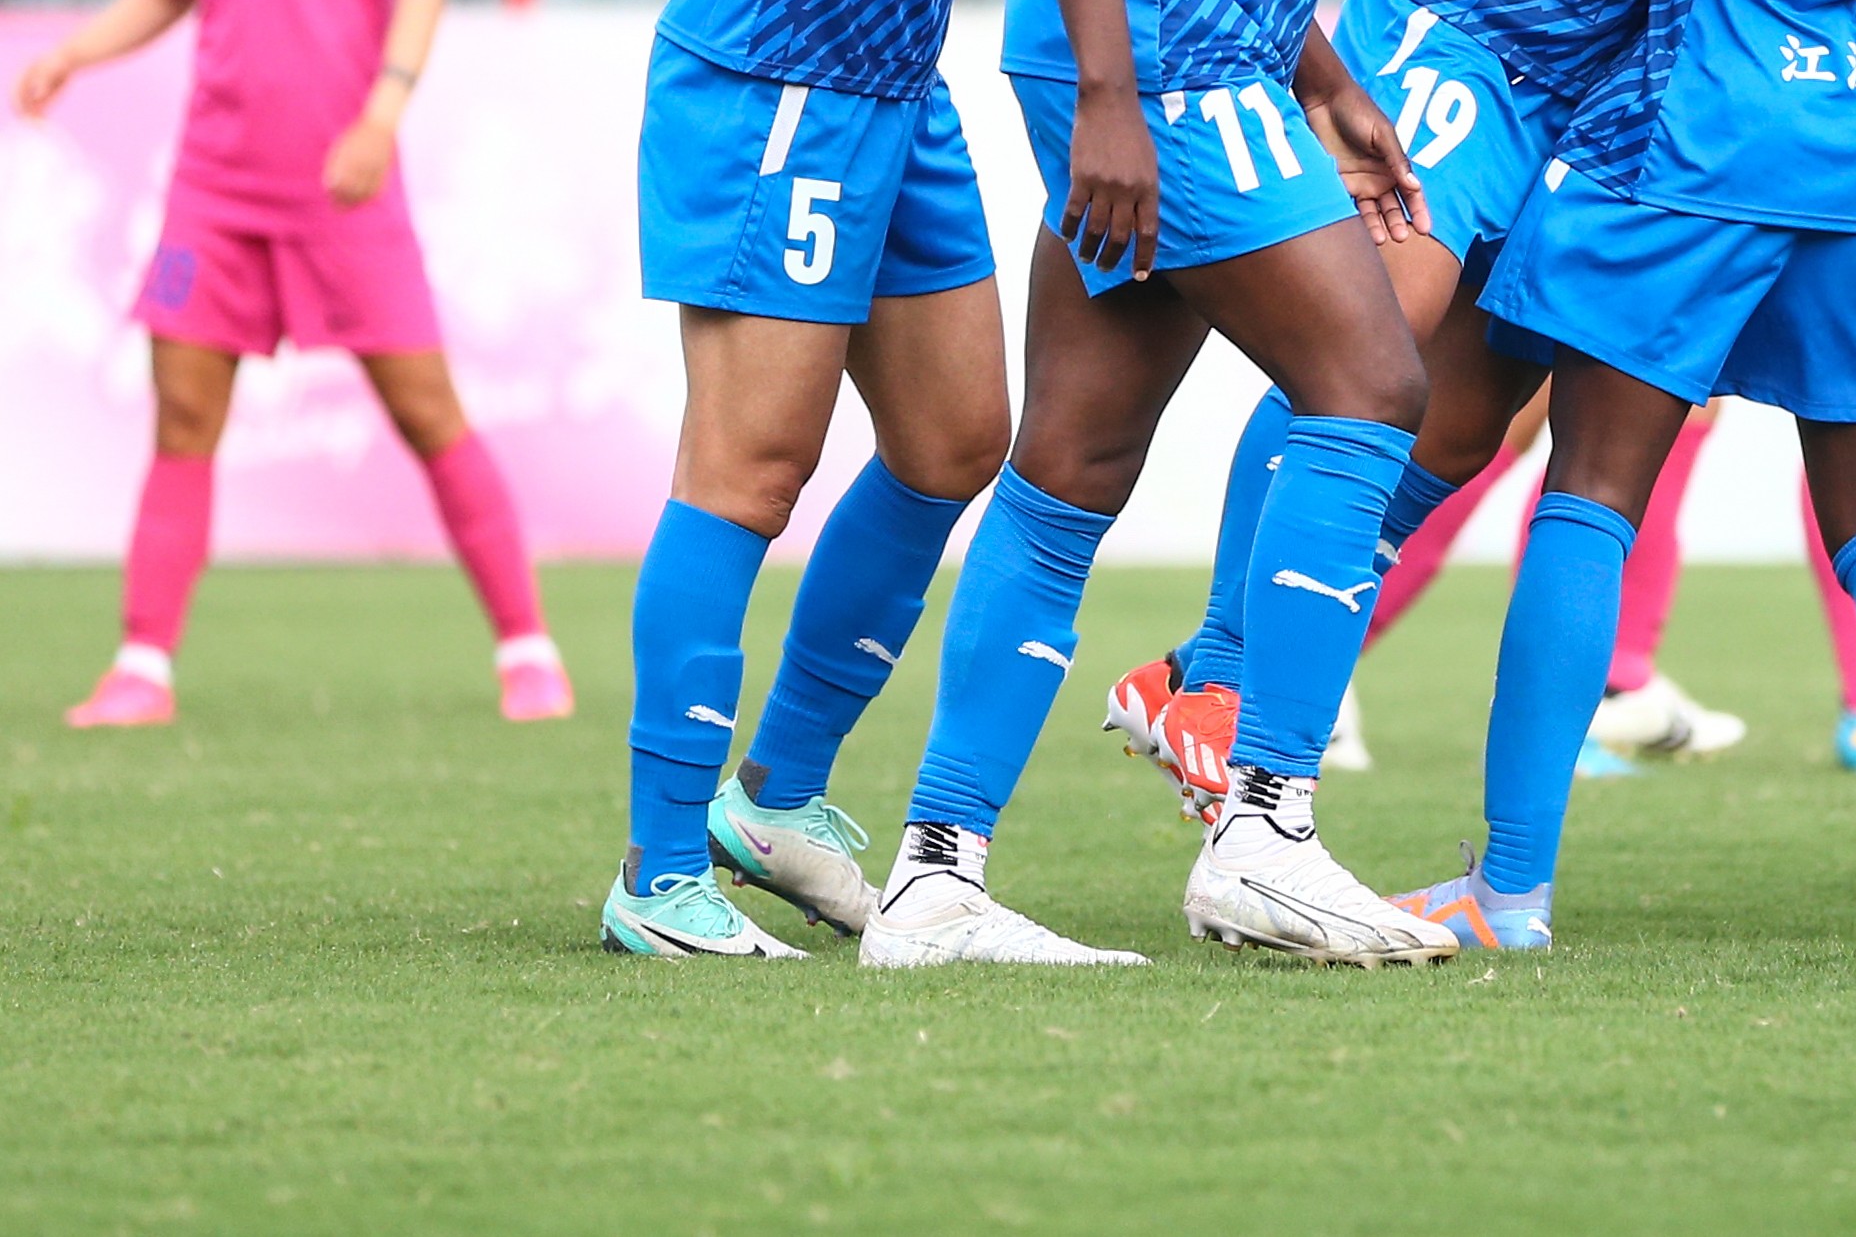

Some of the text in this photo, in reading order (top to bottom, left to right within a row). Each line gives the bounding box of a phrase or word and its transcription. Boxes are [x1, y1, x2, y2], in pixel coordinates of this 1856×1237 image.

[1199, 81, 1302, 193] 11
[1394, 66, 1478, 169] 19
[783, 177, 842, 286] 5
